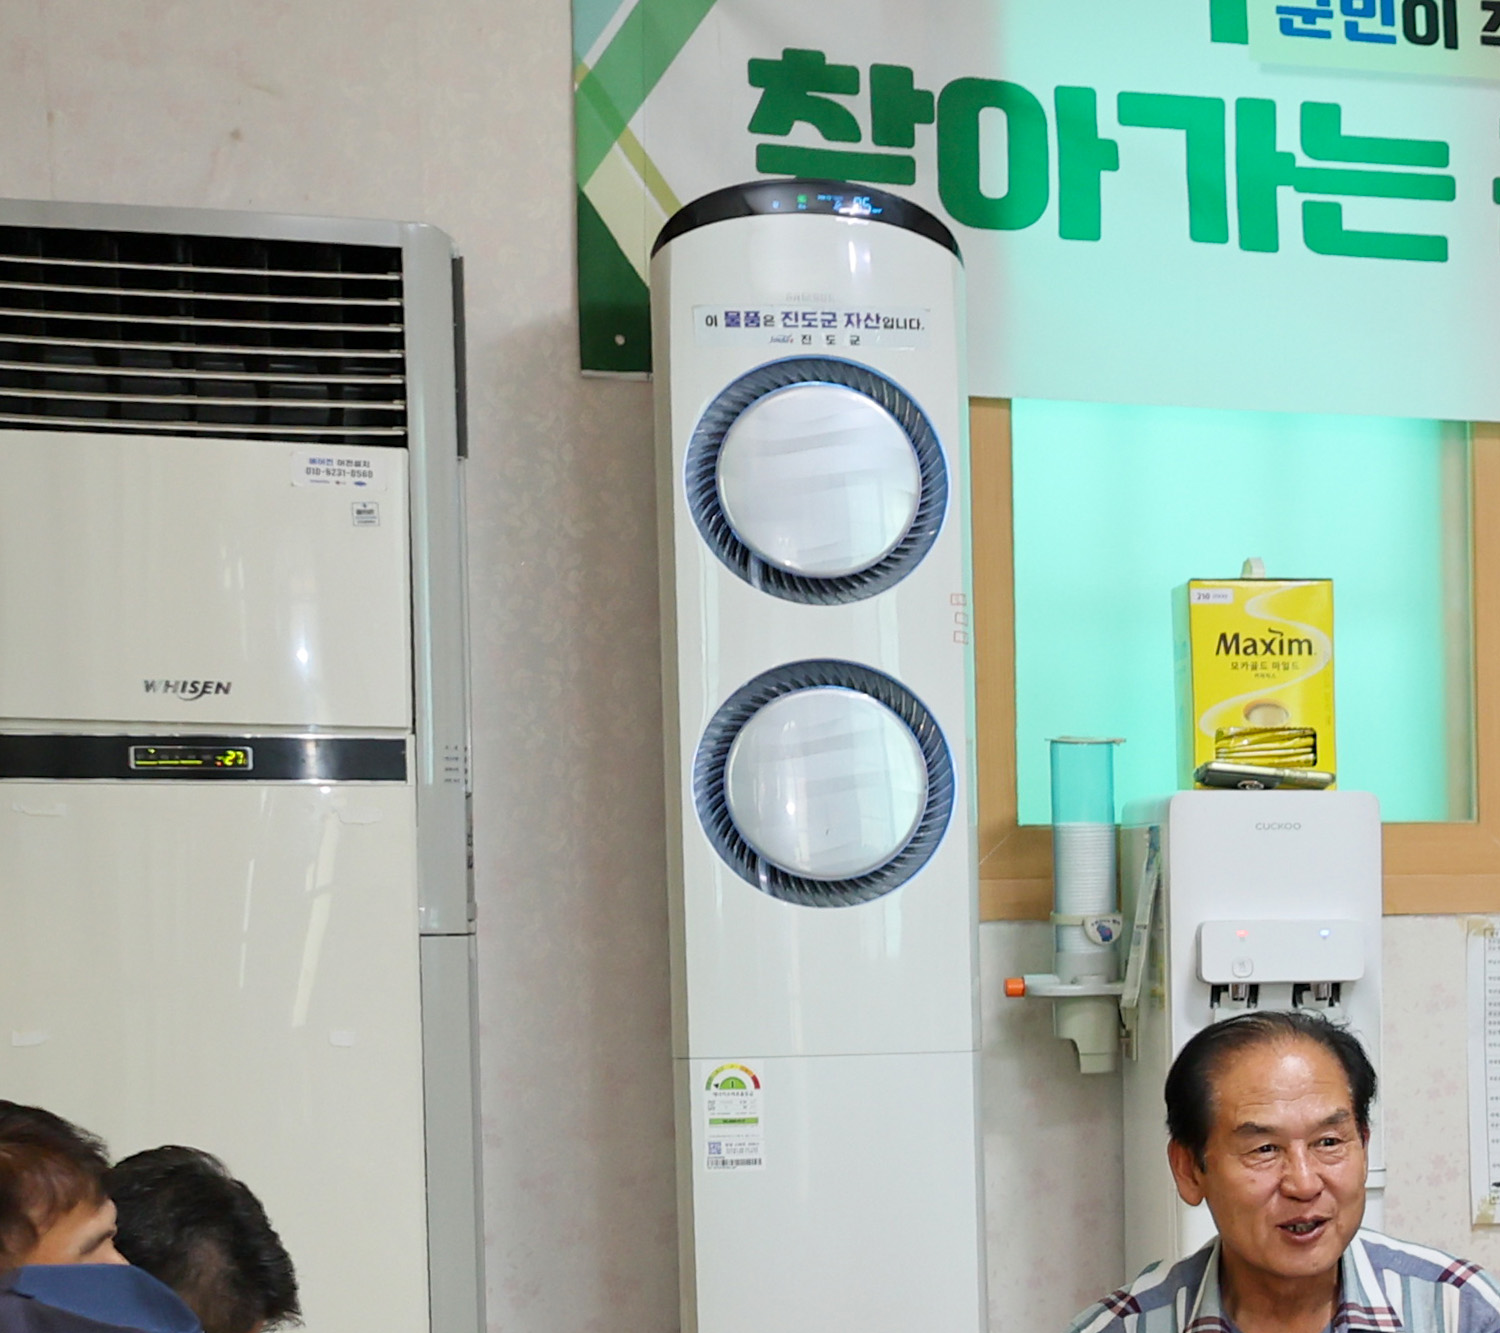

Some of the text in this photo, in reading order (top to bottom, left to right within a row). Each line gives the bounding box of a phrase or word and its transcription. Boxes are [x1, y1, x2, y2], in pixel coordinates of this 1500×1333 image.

[1275, 0, 1458, 50] 군민이
[705, 311, 925, 330] 이 물품은 진도군 자산입니다.
[1215, 628, 1313, 656] Maxim
[1231, 661, 1300, 671] 모카골드 마일드
[144, 679, 232, 700] WHISEN
[1255, 821, 1301, 832] CUCKOO
